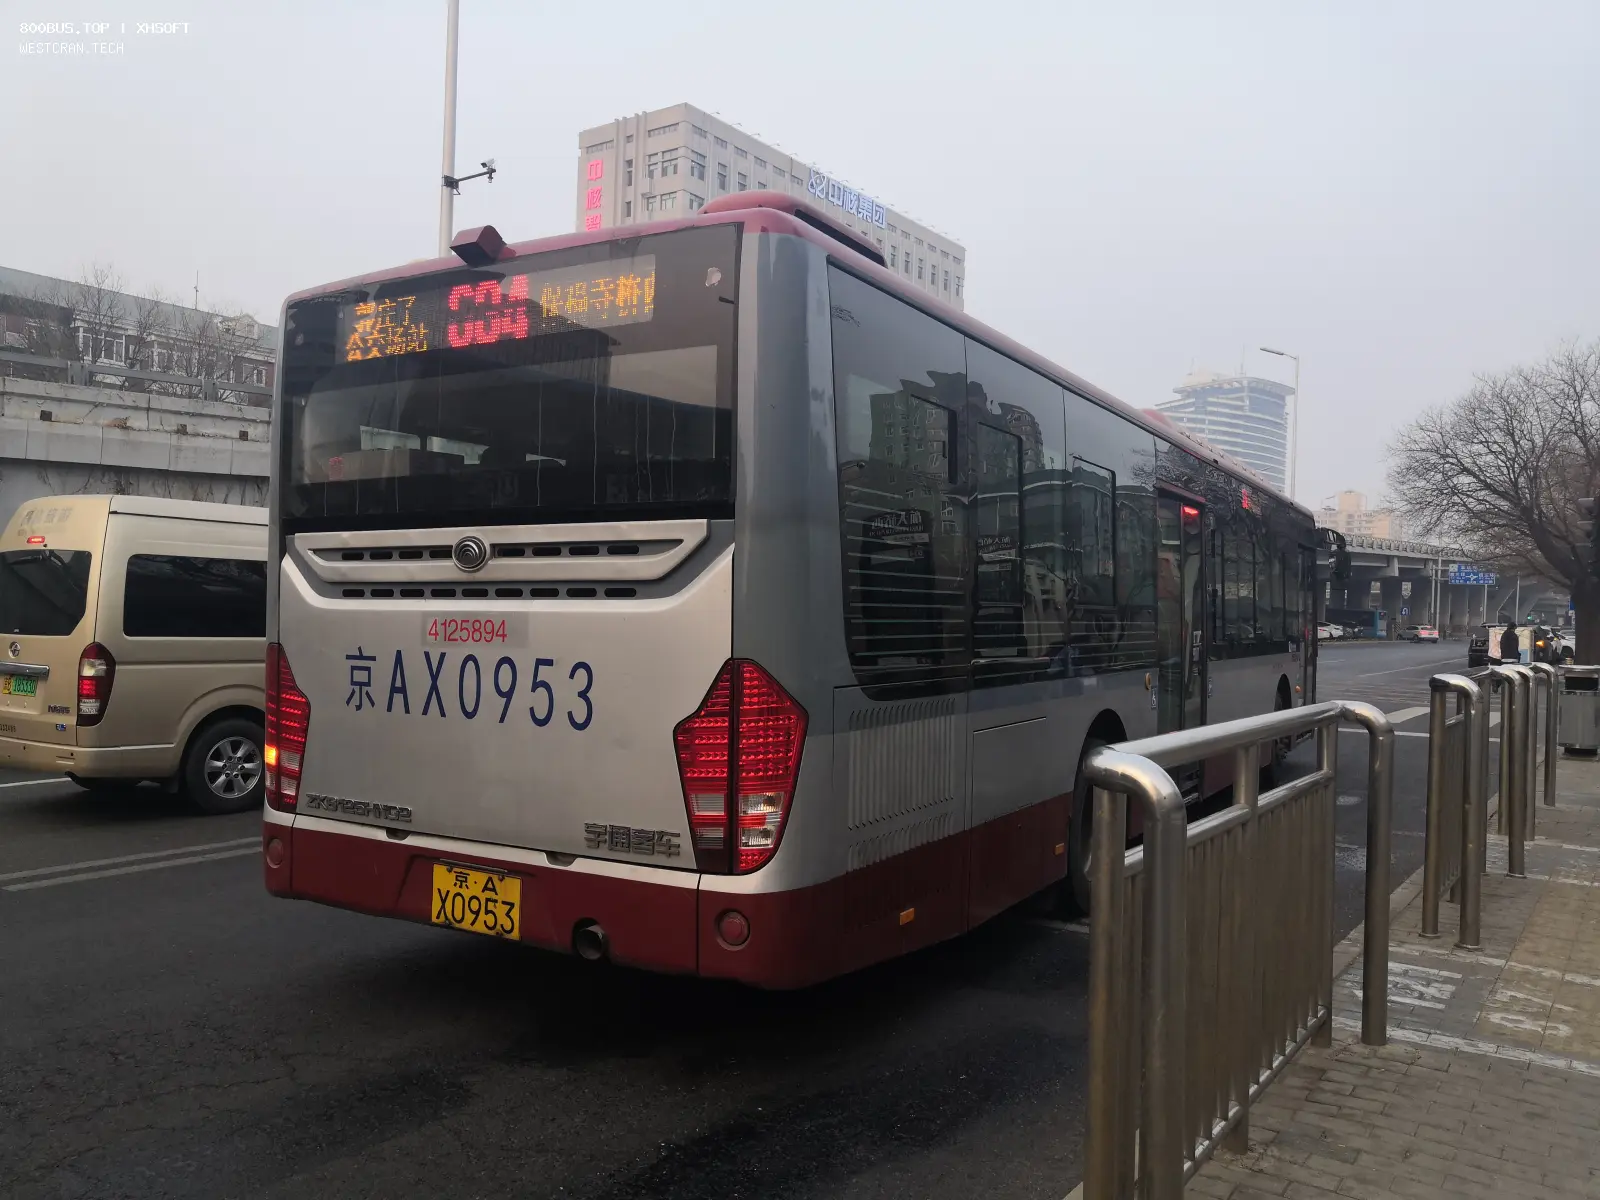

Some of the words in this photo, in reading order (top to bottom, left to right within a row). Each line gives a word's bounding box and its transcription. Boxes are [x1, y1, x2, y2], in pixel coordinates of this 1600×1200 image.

[828, 178, 886, 229] 中核集团
[427, 618, 508, 643] 4125894
[345, 646, 594, 731] 京AX0953
[584, 821, 681, 859] 宇通客车
[436, 887, 516, 934] X0953
